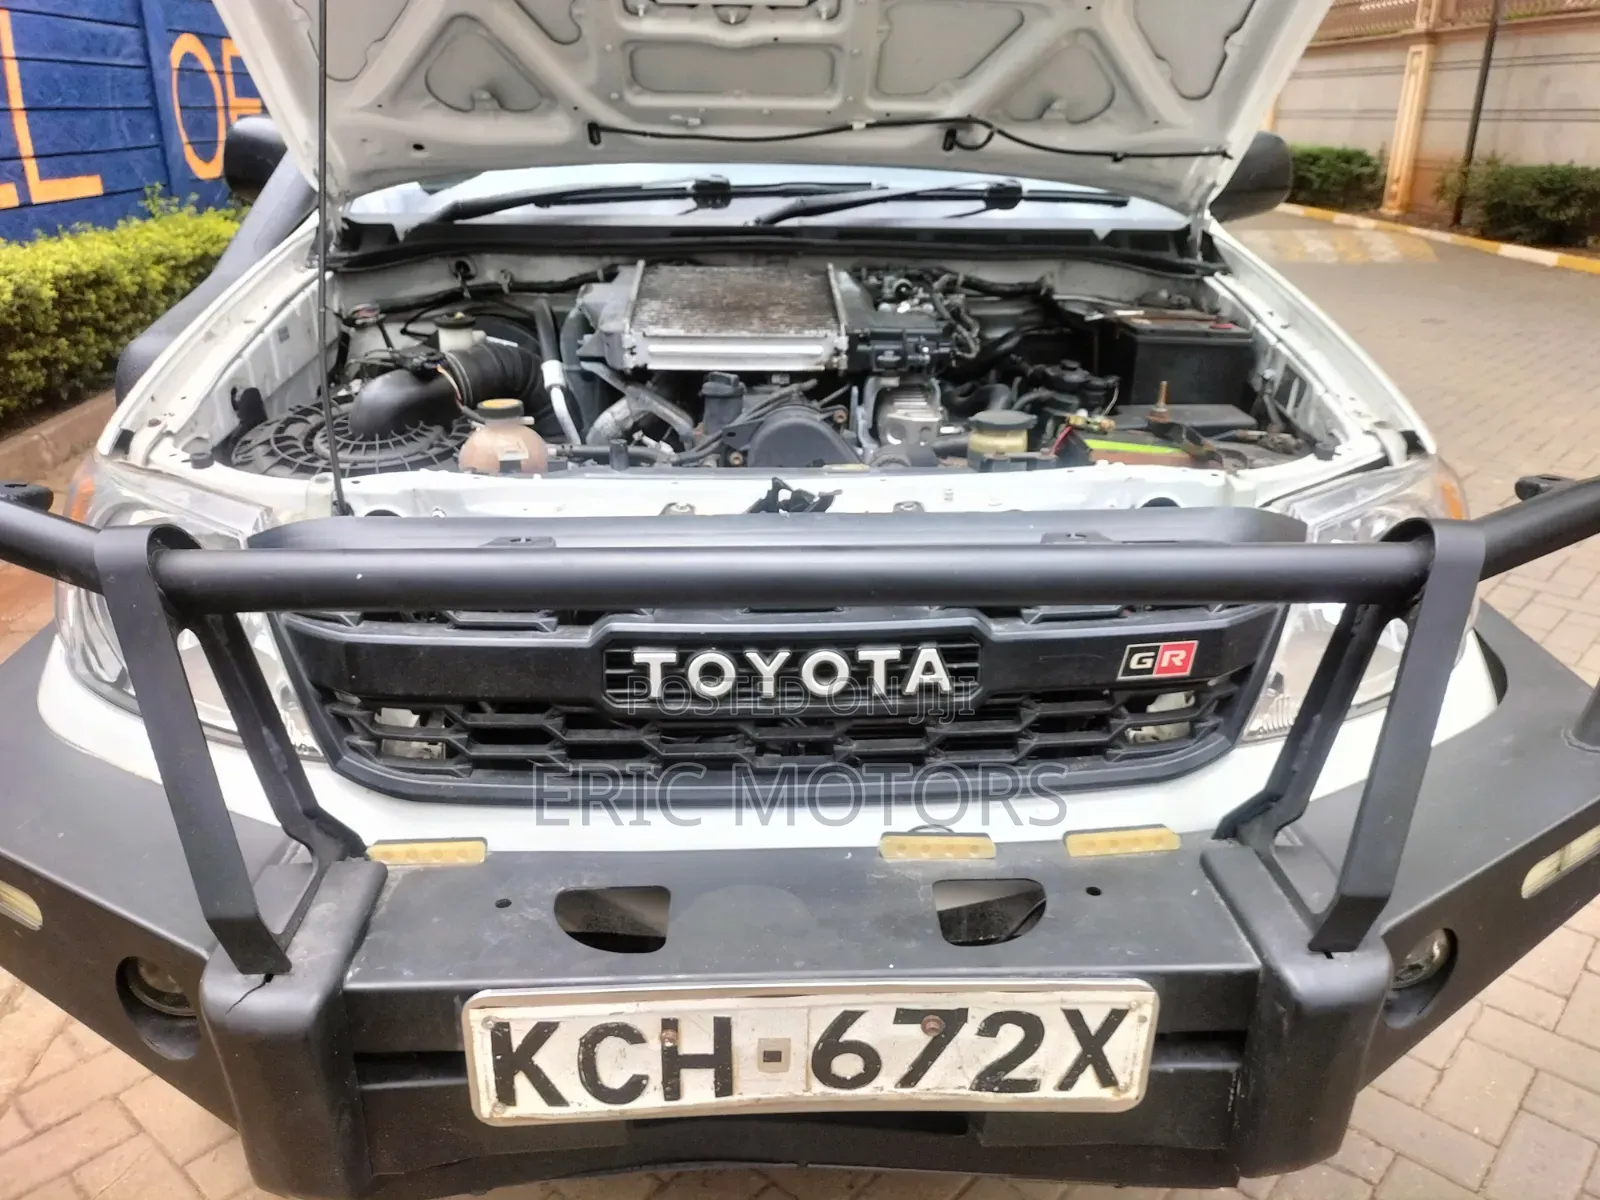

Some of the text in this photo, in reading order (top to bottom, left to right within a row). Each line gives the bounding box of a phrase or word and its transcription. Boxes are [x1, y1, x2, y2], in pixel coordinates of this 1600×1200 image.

[632, 648, 953, 699] TOYOTA
[490, 1008, 1130, 1108] KCH 672X
